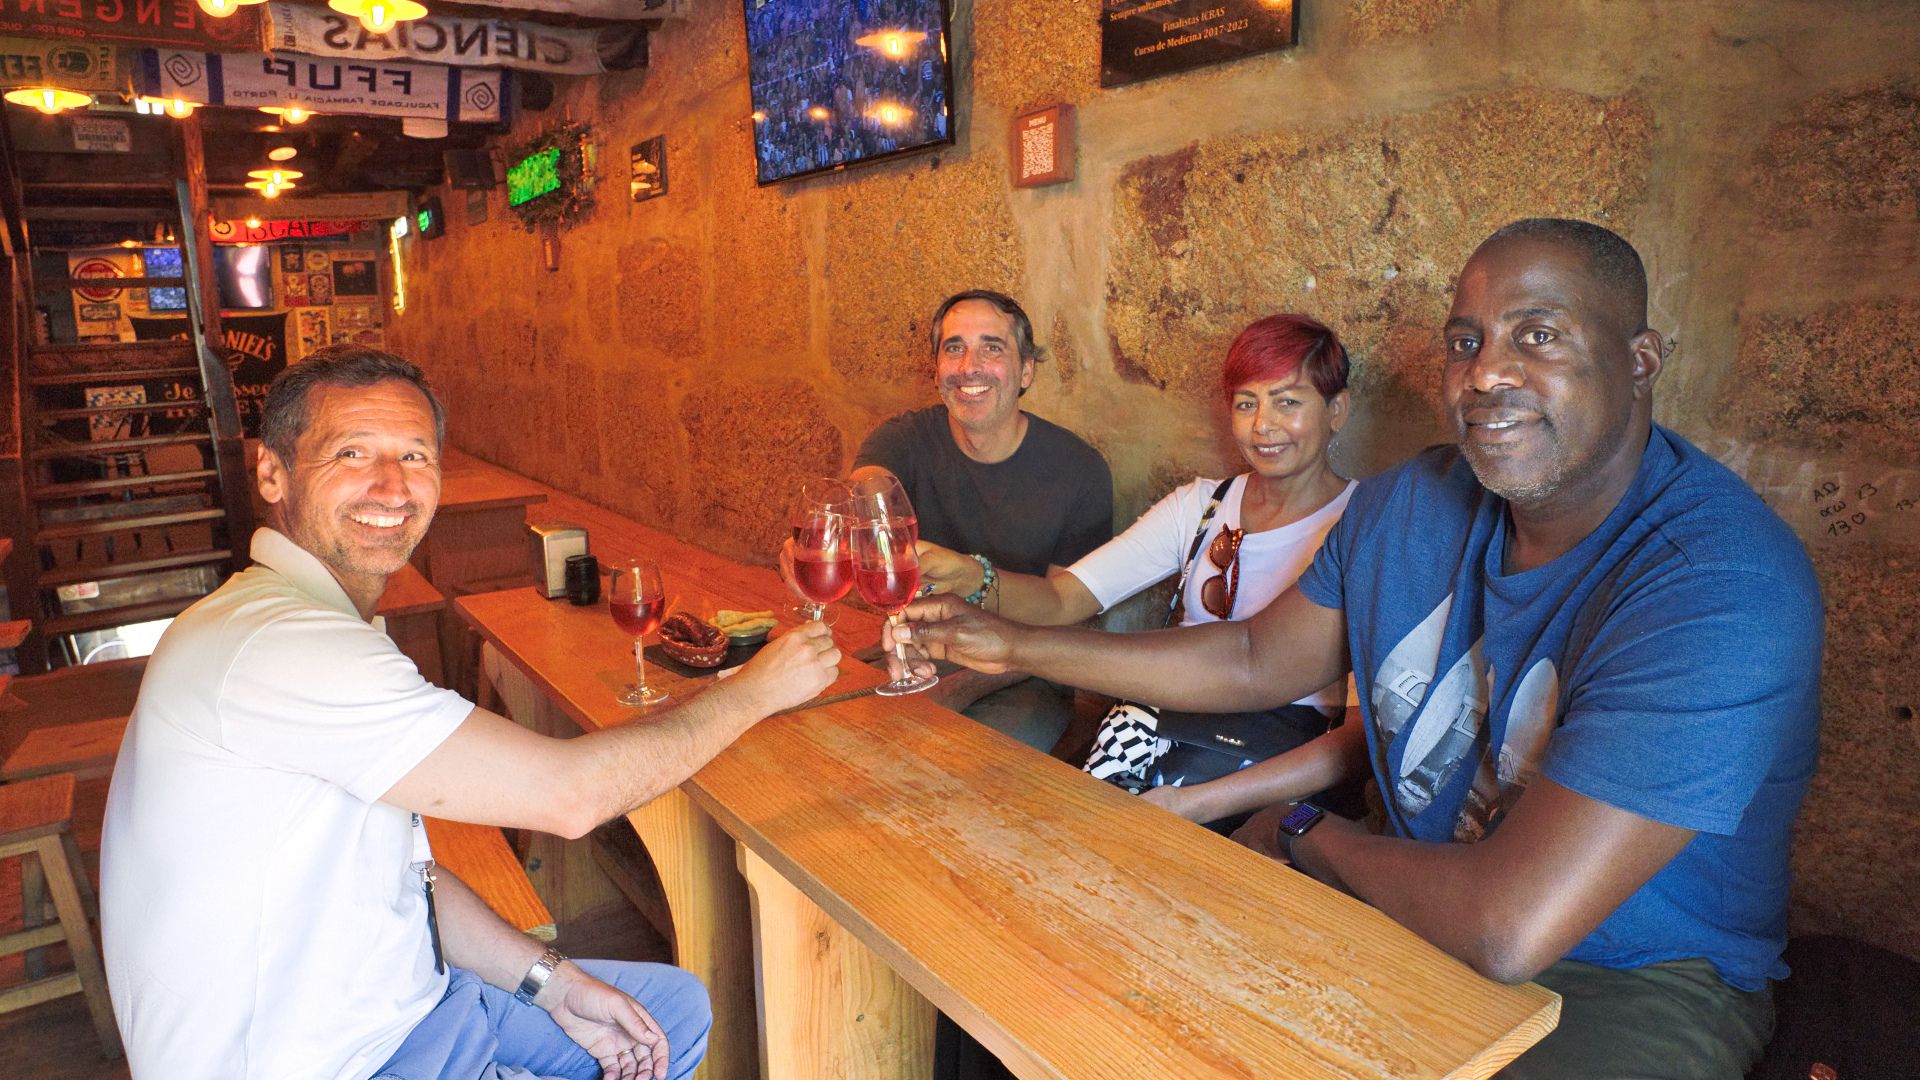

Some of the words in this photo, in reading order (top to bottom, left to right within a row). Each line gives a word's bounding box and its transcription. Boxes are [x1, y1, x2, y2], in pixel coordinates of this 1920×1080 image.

[1163, 15, 1199, 32] Finalistas
[1201, 6, 1225, 22] ICBAS
[1134, 46, 1155, 56] Curso
[1156, 41, 1166, 51] de
[1167, 32, 1202, 49] Medicina
[1203, 18, 1249, 39] 2017-2023
